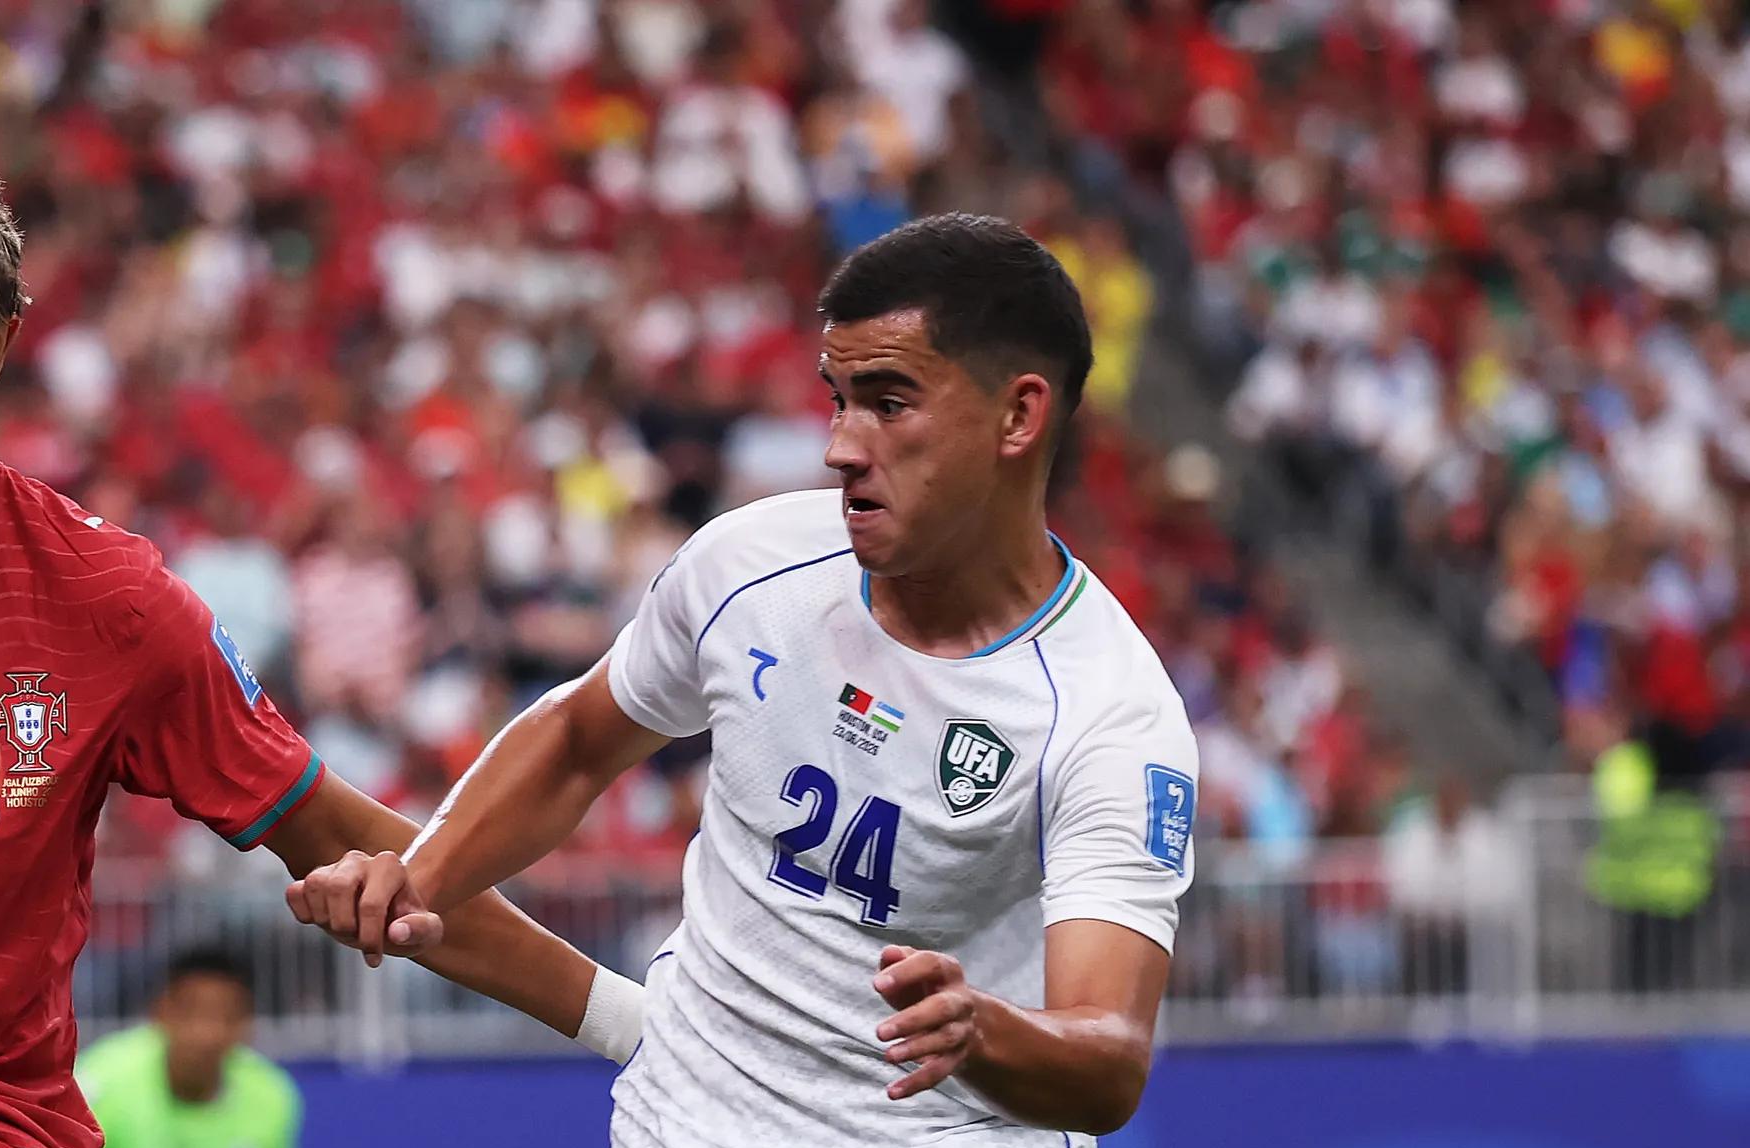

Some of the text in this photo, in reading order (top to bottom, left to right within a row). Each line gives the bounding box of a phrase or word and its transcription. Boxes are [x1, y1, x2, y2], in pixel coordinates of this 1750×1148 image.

[947, 732, 1000, 782] UFA
[1, 787, 7, 798] 3
[9, 787, 39, 797] JUNHO
[768, 764, 900, 928] 24
